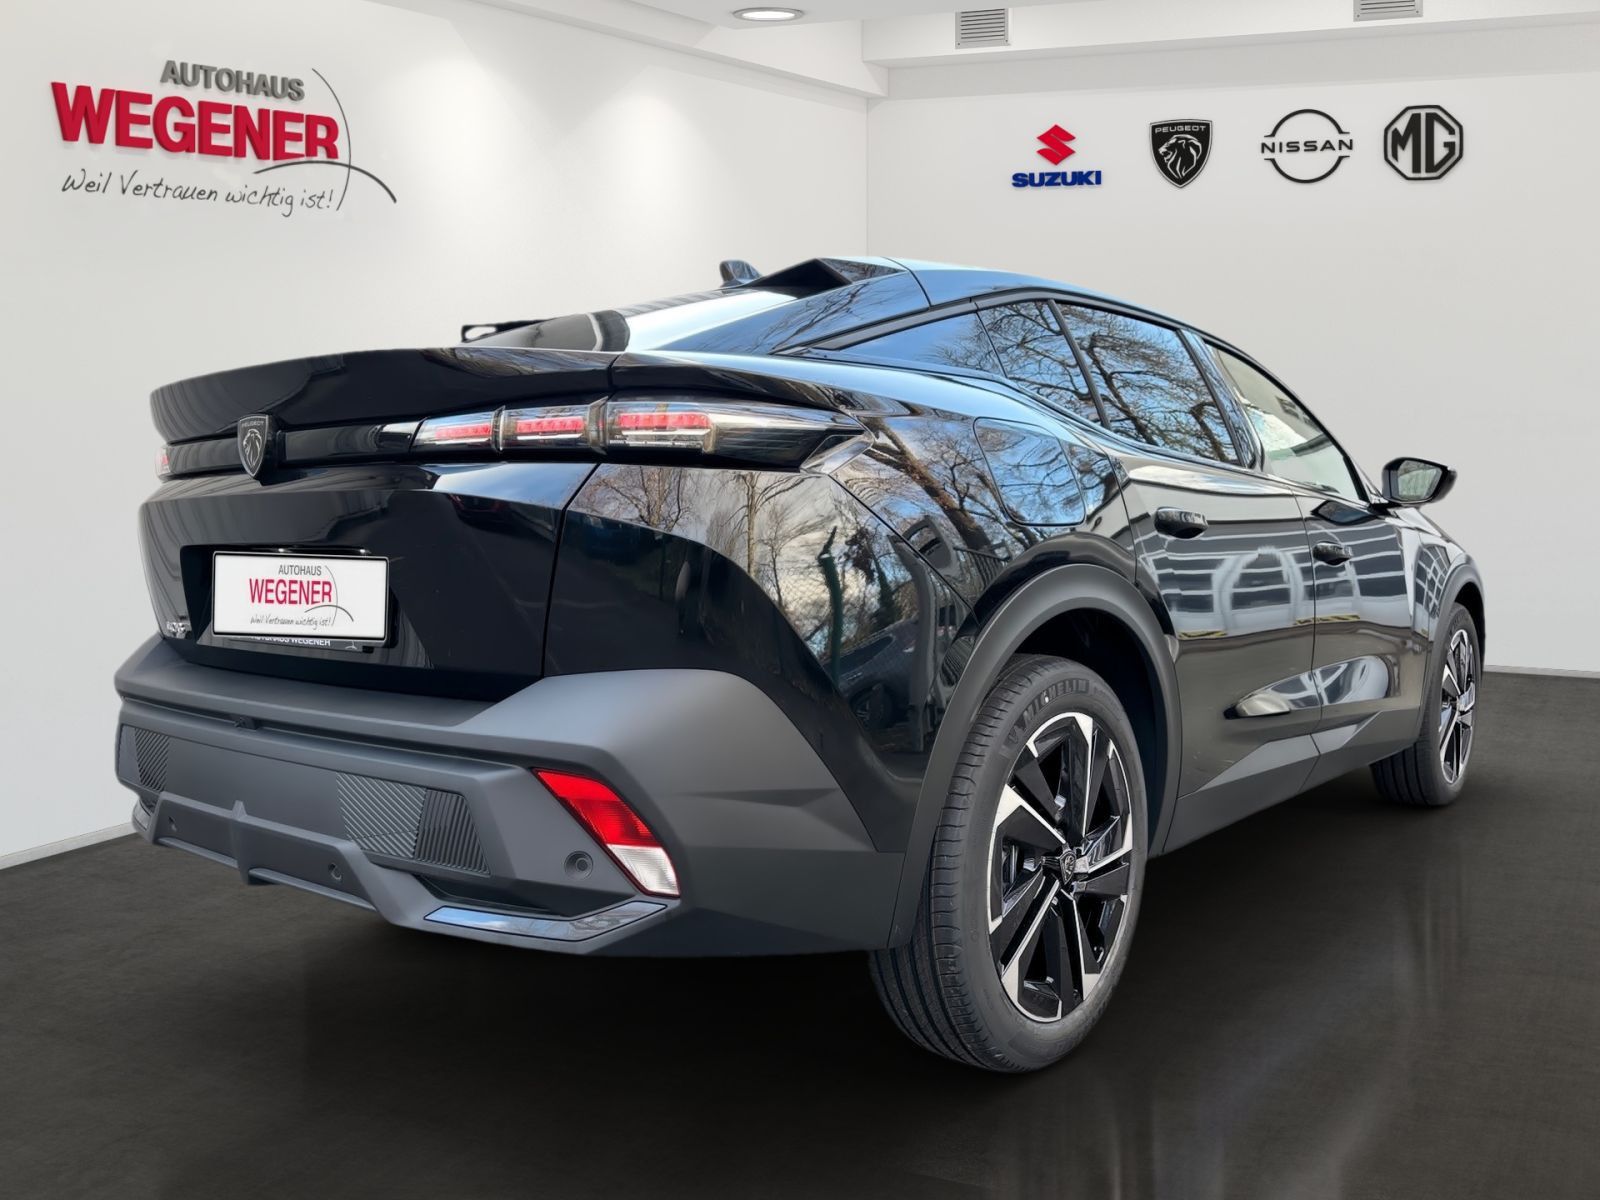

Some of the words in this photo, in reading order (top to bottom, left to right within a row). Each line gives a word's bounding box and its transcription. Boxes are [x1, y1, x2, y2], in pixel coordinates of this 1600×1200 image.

[160, 60, 305, 101] AUTOHAUS
[51, 82, 340, 161] WEGENER
[1154, 124, 1207, 134] PEUGEOT
[1261, 138, 1354, 155] NISSAN
[1391, 112, 1456, 174] MG
[61, 168, 112, 193] Weil
[120, 169, 218, 201] Vertrauen
[225, 184, 294, 218] wichtig
[300, 188, 334, 209] ist!
[1011, 170, 1102, 188] SUZUKI
[278, 565, 322, 576] AUTOHAUS
[249, 578, 332, 604] WEGENER
[1023, 678, 1090, 726] MICHELIN
